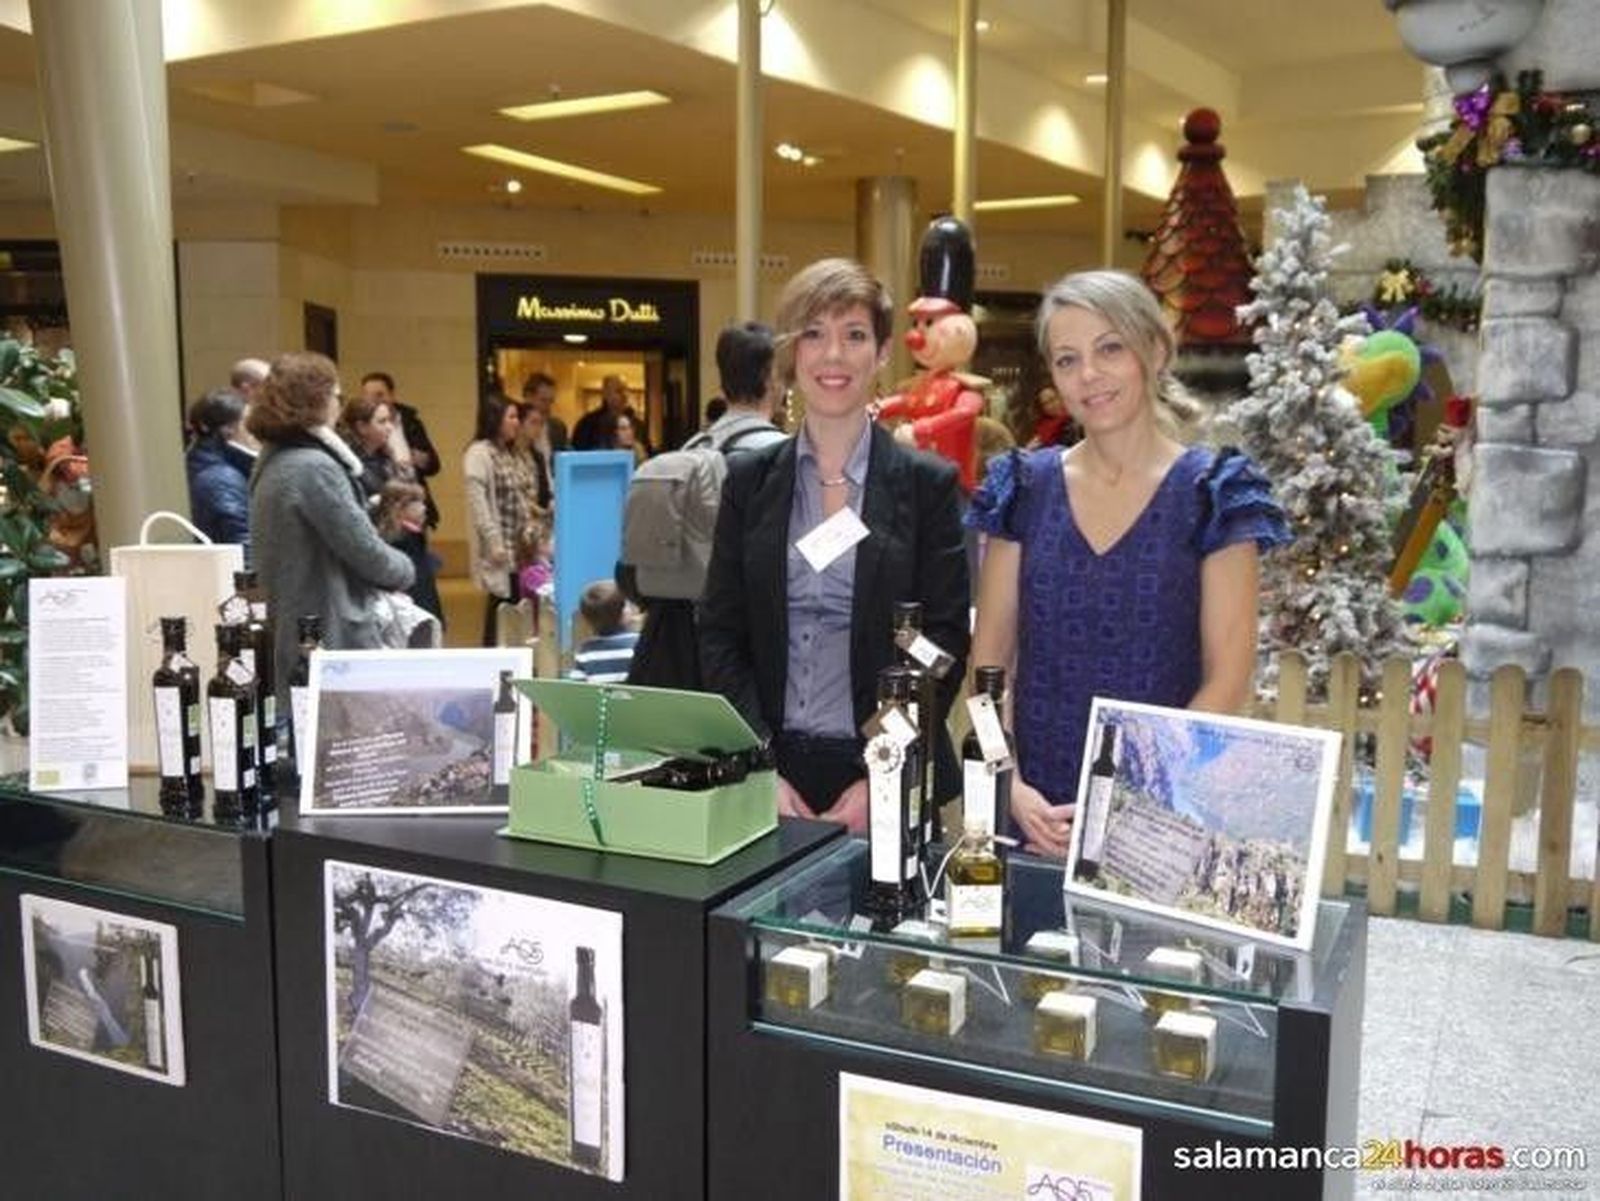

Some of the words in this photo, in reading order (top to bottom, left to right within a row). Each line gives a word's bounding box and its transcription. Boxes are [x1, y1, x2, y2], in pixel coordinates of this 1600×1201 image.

[517, 297, 605, 320] Massimo
[609, 298, 660, 322] Dutti
[882, 1134, 1002, 1174] Presentación
